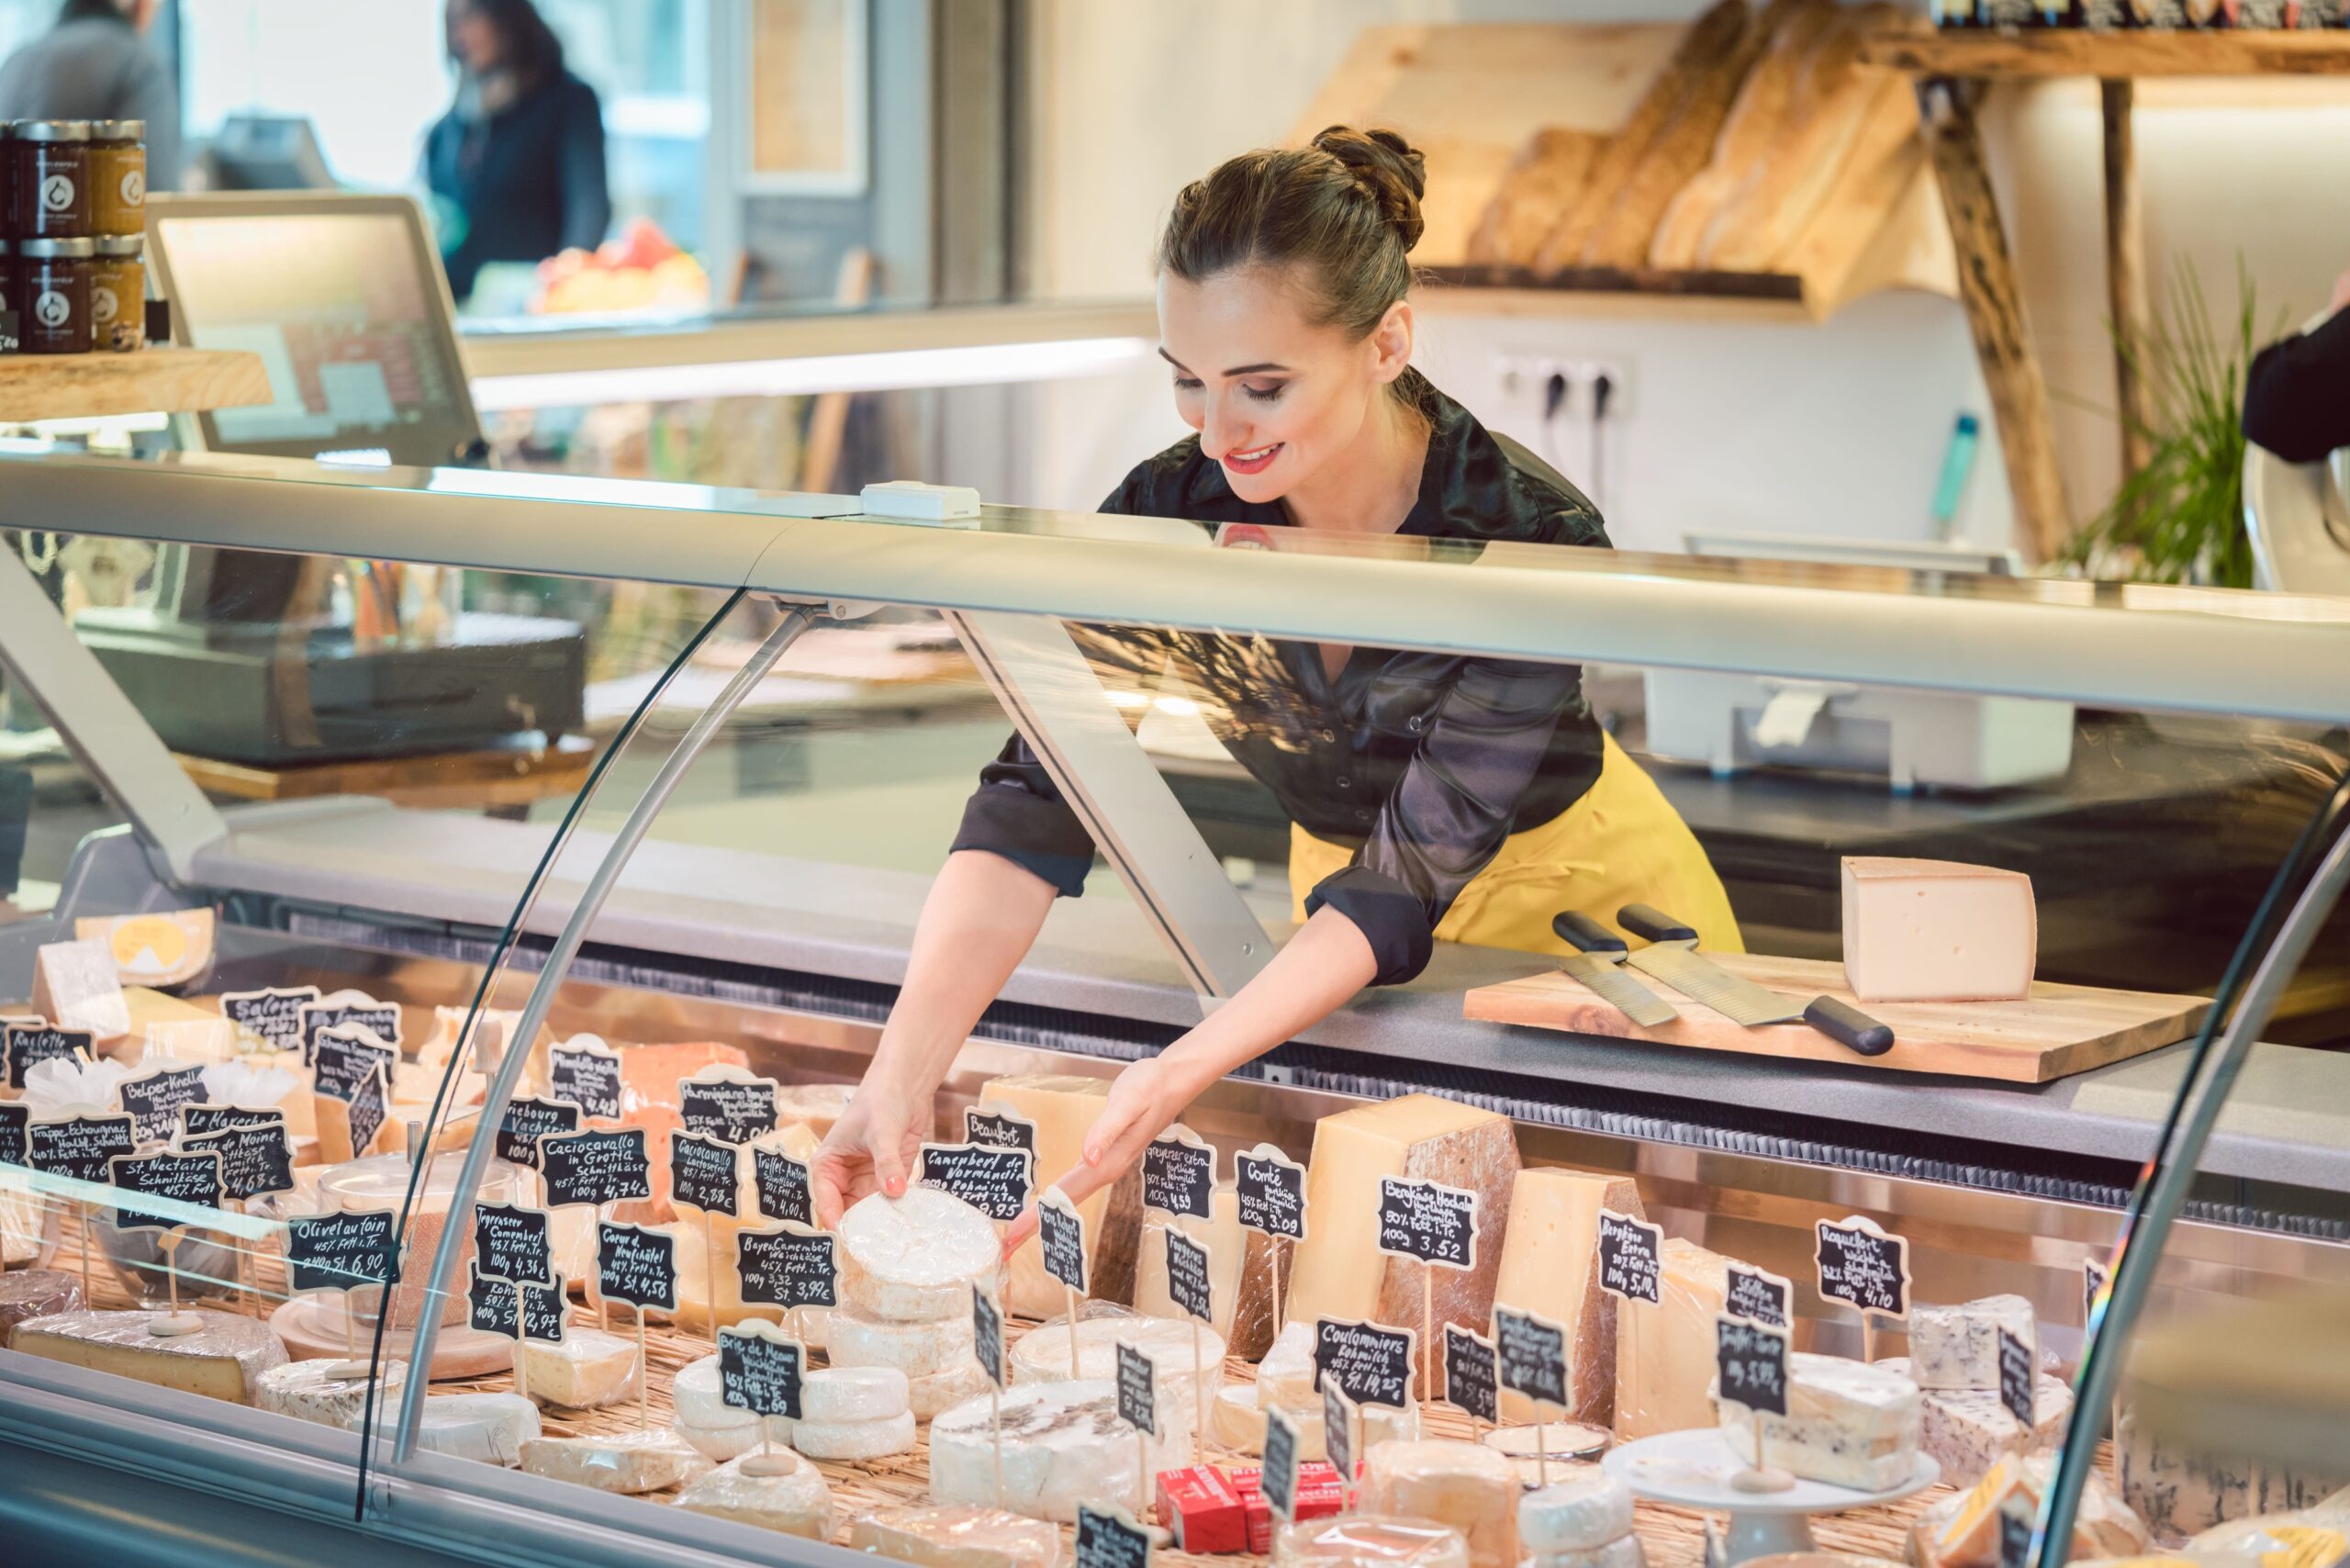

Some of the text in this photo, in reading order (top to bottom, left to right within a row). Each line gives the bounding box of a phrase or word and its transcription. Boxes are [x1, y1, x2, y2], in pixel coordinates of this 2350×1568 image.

[126, 1080, 169, 1101] Belper
[188, 1111, 207, 1127] Le
[507, 1103, 559, 1122] riebourg
[31, 1125, 68, 1143] Trappe
[969, 1114, 1021, 1145] Beaufort
[33, 1148, 56, 1160] 40%
[58, 1148, 81, 1159] Fett
[221, 1138, 235, 1152] de
[508, 1145, 536, 1164] 100g
[546, 1134, 635, 1156] Caciocavallo
[677, 1138, 732, 1167] Caciocavallo
[126, 1157, 216, 1175] St. Nectaire
[568, 1149, 634, 1165] in Grotta
[1006, 1156, 1024, 1170] de
[1183, 1150, 1212, 1168] extra
[575, 1161, 645, 1177] Schnittkäse
[682, 1166, 698, 1180] 45%
[699, 1170, 715, 1183] Fett
[945, 1166, 1024, 1182] Normandie
[1248, 1161, 1283, 1187] Comté
[164, 1182, 215, 1196] 45% Fett
[231, 1174, 278, 1196] 4,68 €
[554, 1177, 576, 1188] 45%
[577, 1175, 599, 1186] Fett
[571, 1179, 641, 1202] 100g 4,74
[765, 1182, 778, 1194] 50%
[778, 1184, 791, 1197] Fett
[1160, 1177, 1175, 1191] Fett
[678, 1180, 733, 1209] 100g 2,88 €
[763, 1193, 777, 1212] 100g
[1147, 1188, 1169, 1208] 100g
[1241, 1193, 1270, 1211] 45% Fett
[1384, 1181, 1435, 1209] Bergkäse
[297, 1216, 386, 1238] Olivet au foin
[476, 1206, 523, 1229] Tegernseer
[1240, 1206, 1299, 1234] 100g 3.09
[1385, 1209, 1434, 1233] 50% Fett
[602, 1227, 631, 1245] Coeur
[1601, 1218, 1644, 1244] Bergkäse
[1820, 1225, 1882, 1253] Roquefort
[314, 1233, 381, 1253] 45% Fett Tr.
[490, 1240, 508, 1253] 45%
[509, 1241, 527, 1255] Fett
[774, 1237, 833, 1255] Camembert
[1382, 1227, 1461, 1260] 100g 3,52
[1620, 1239, 1651, 1259] Extra
[331, 1255, 348, 1273] St.
[352, 1252, 384, 1277] 6,90
[490, 1252, 546, 1280] 100g 4,36 €
[768, 1249, 823, 1263] Weichkäse
[1612, 1253, 1629, 1271] 50%
[610, 1259, 628, 1274] 45%
[630, 1260, 648, 1274] Fett
[760, 1259, 783, 1274] 45%
[817, 1262, 832, 1276] Tr.
[622, 1274, 638, 1294] St.
[744, 1272, 793, 1290] 100g 3,32
[1606, 1266, 1628, 1291] 100g
[1629, 1272, 1653, 1295] 5,10
[485, 1294, 505, 1309] 50%
[773, 1280, 832, 1303] St. 3,99 €
[1834, 1283, 1894, 1309] 100g 4,10
[476, 1305, 498, 1328] 400g
[720, 1334, 745, 1354] Brie
[746, 1339, 764, 1356] de
[1322, 1324, 1404, 1355] Coulommiers
[1337, 1343, 1390, 1365] Rohmilch
[1330, 1357, 1374, 1373] 45% Fett
[1345, 1371, 1362, 1391] St.
[1362, 1372, 1404, 1397] 14,25
[726, 1389, 789, 1416] 100g 2,69
